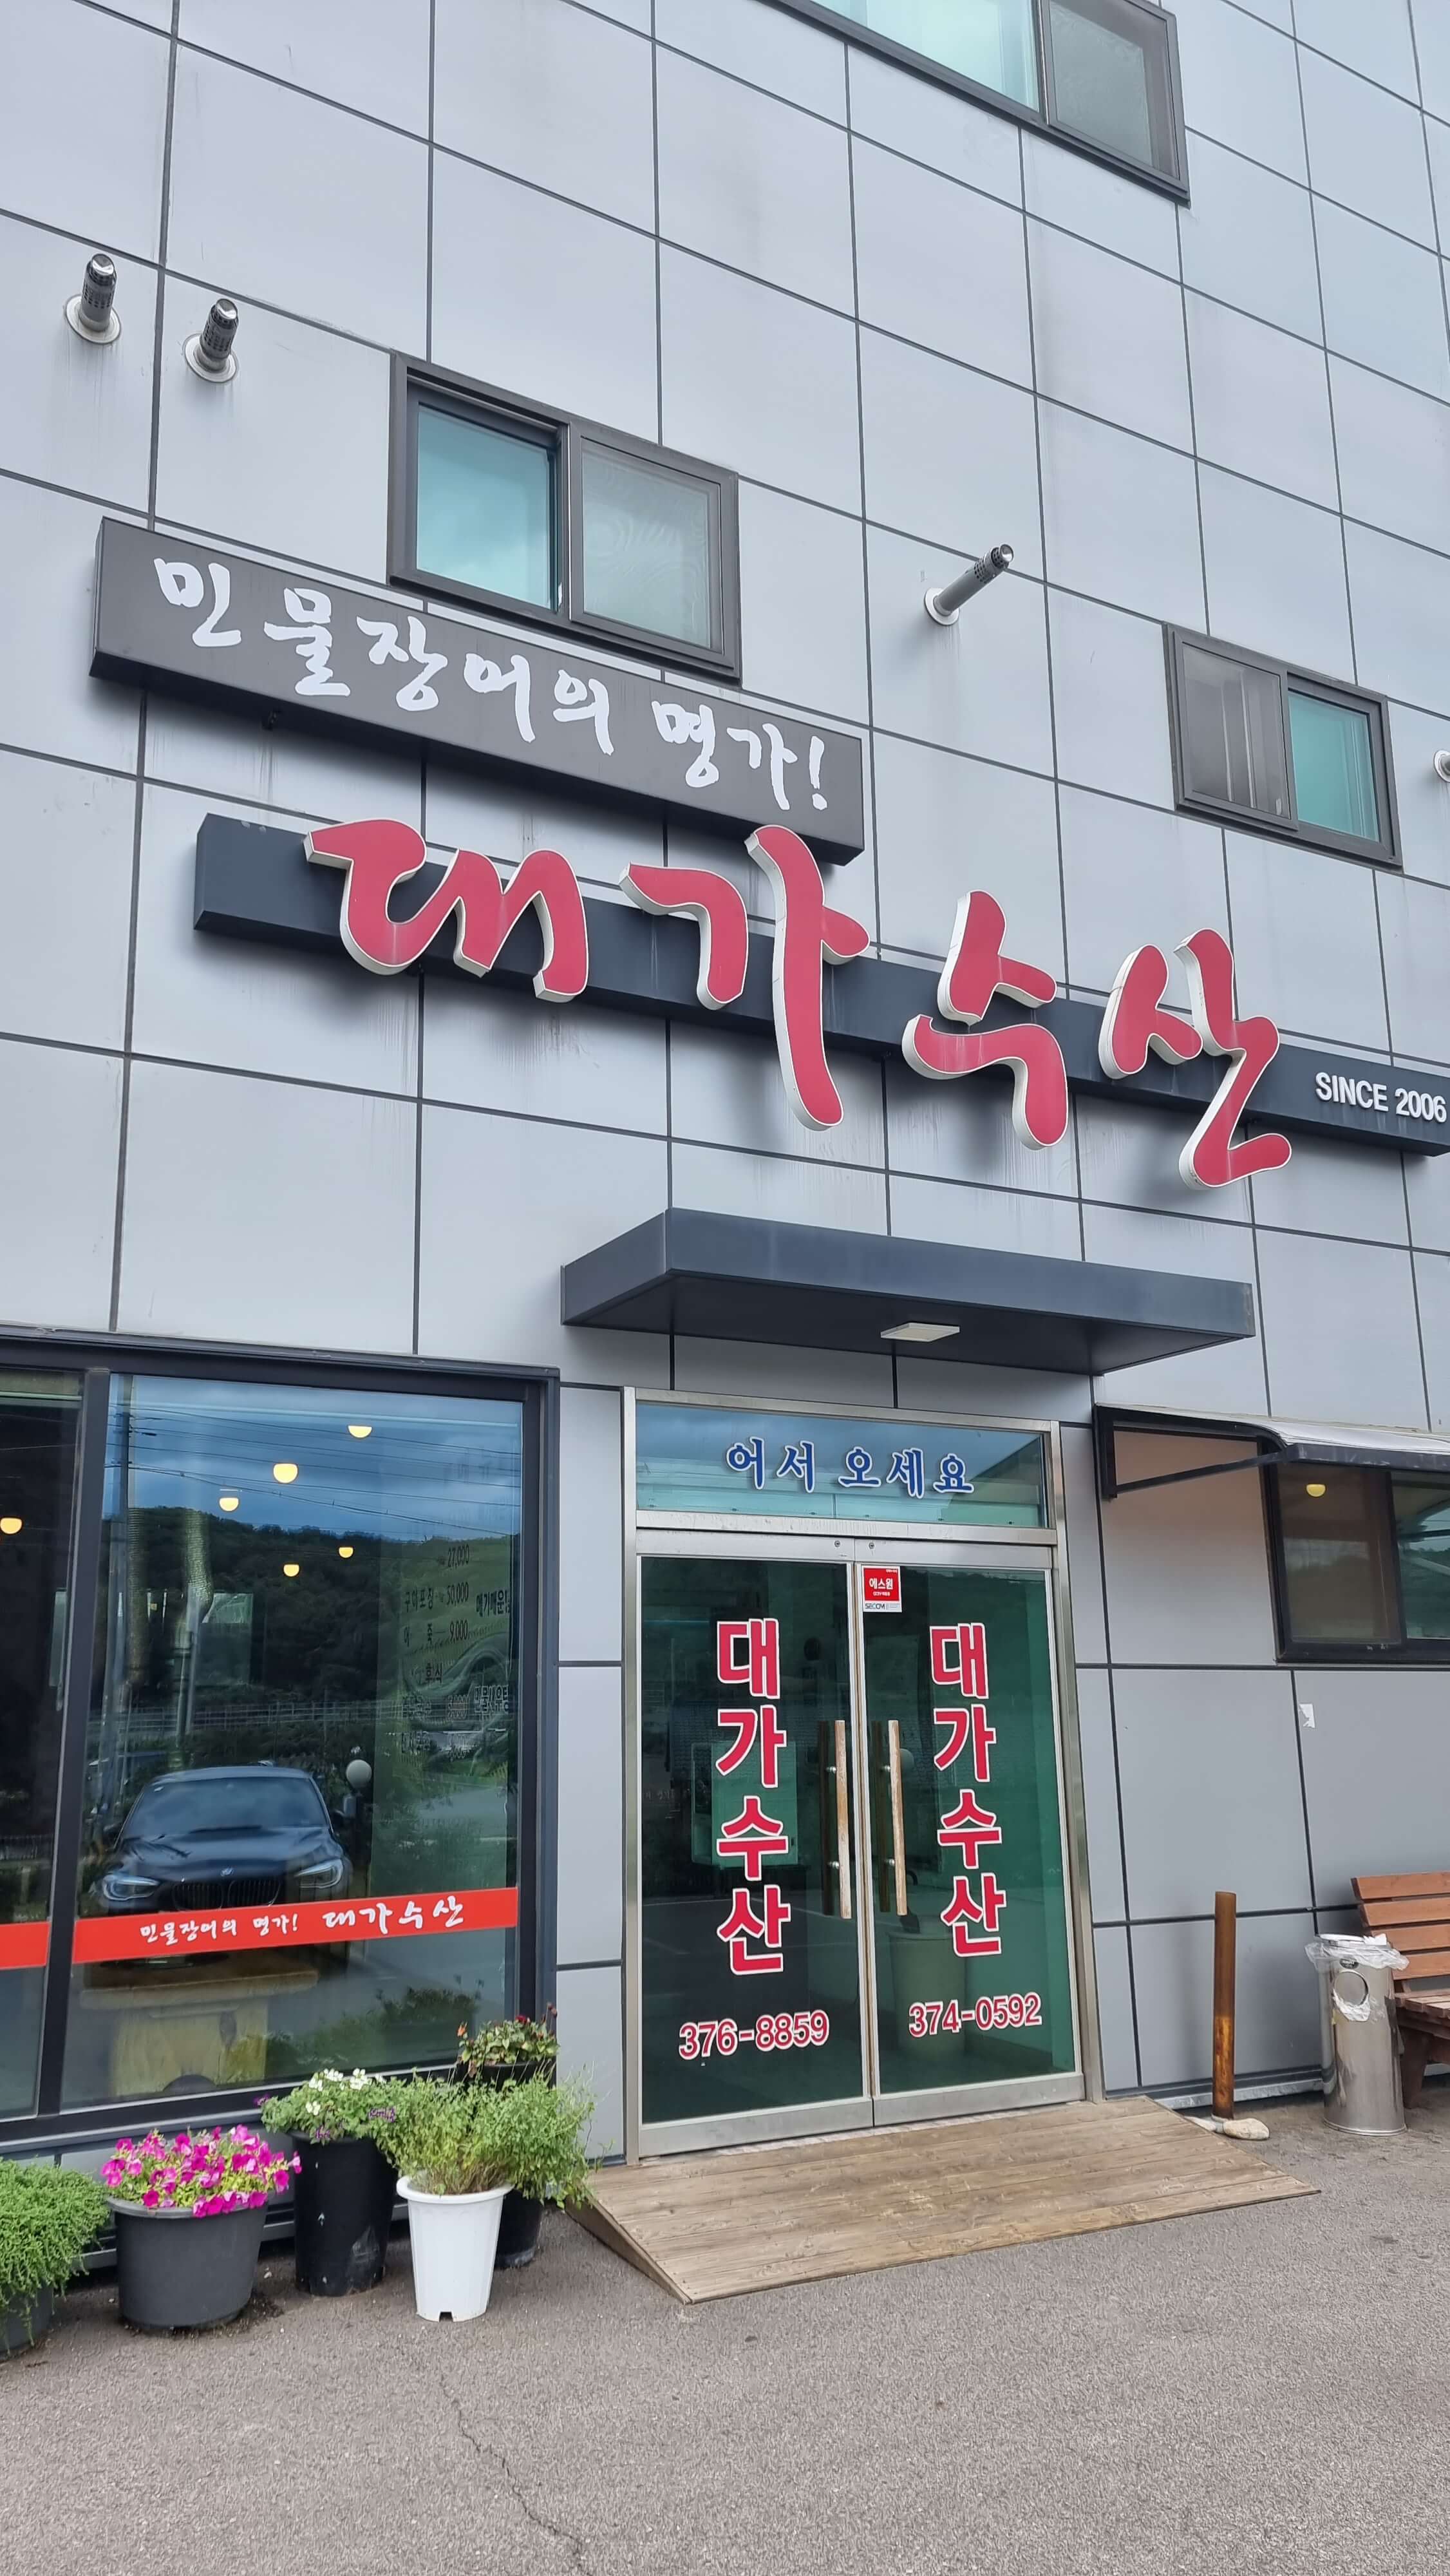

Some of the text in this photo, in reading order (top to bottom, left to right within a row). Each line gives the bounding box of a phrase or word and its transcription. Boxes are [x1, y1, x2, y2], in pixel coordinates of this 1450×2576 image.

[153, 558, 828, 811] 민물장어의 명가!
[305, 818, 1292, 1191] 대가수산
[1315, 1072, 1447, 1123] SINCE 2006
[838, 1446, 975, 1499] 오세요
[869, 1577, 894, 1590] 에스원
[715, 1618, 791, 1976] 대가수산
[928, 1622, 1006, 1958] 대가수산
[140, 1895, 464, 1946] 민물장어의 명가! 대가수산
[679, 2010, 830, 2060] 376-8859
[909, 1992, 1042, 2038] 374-0592
